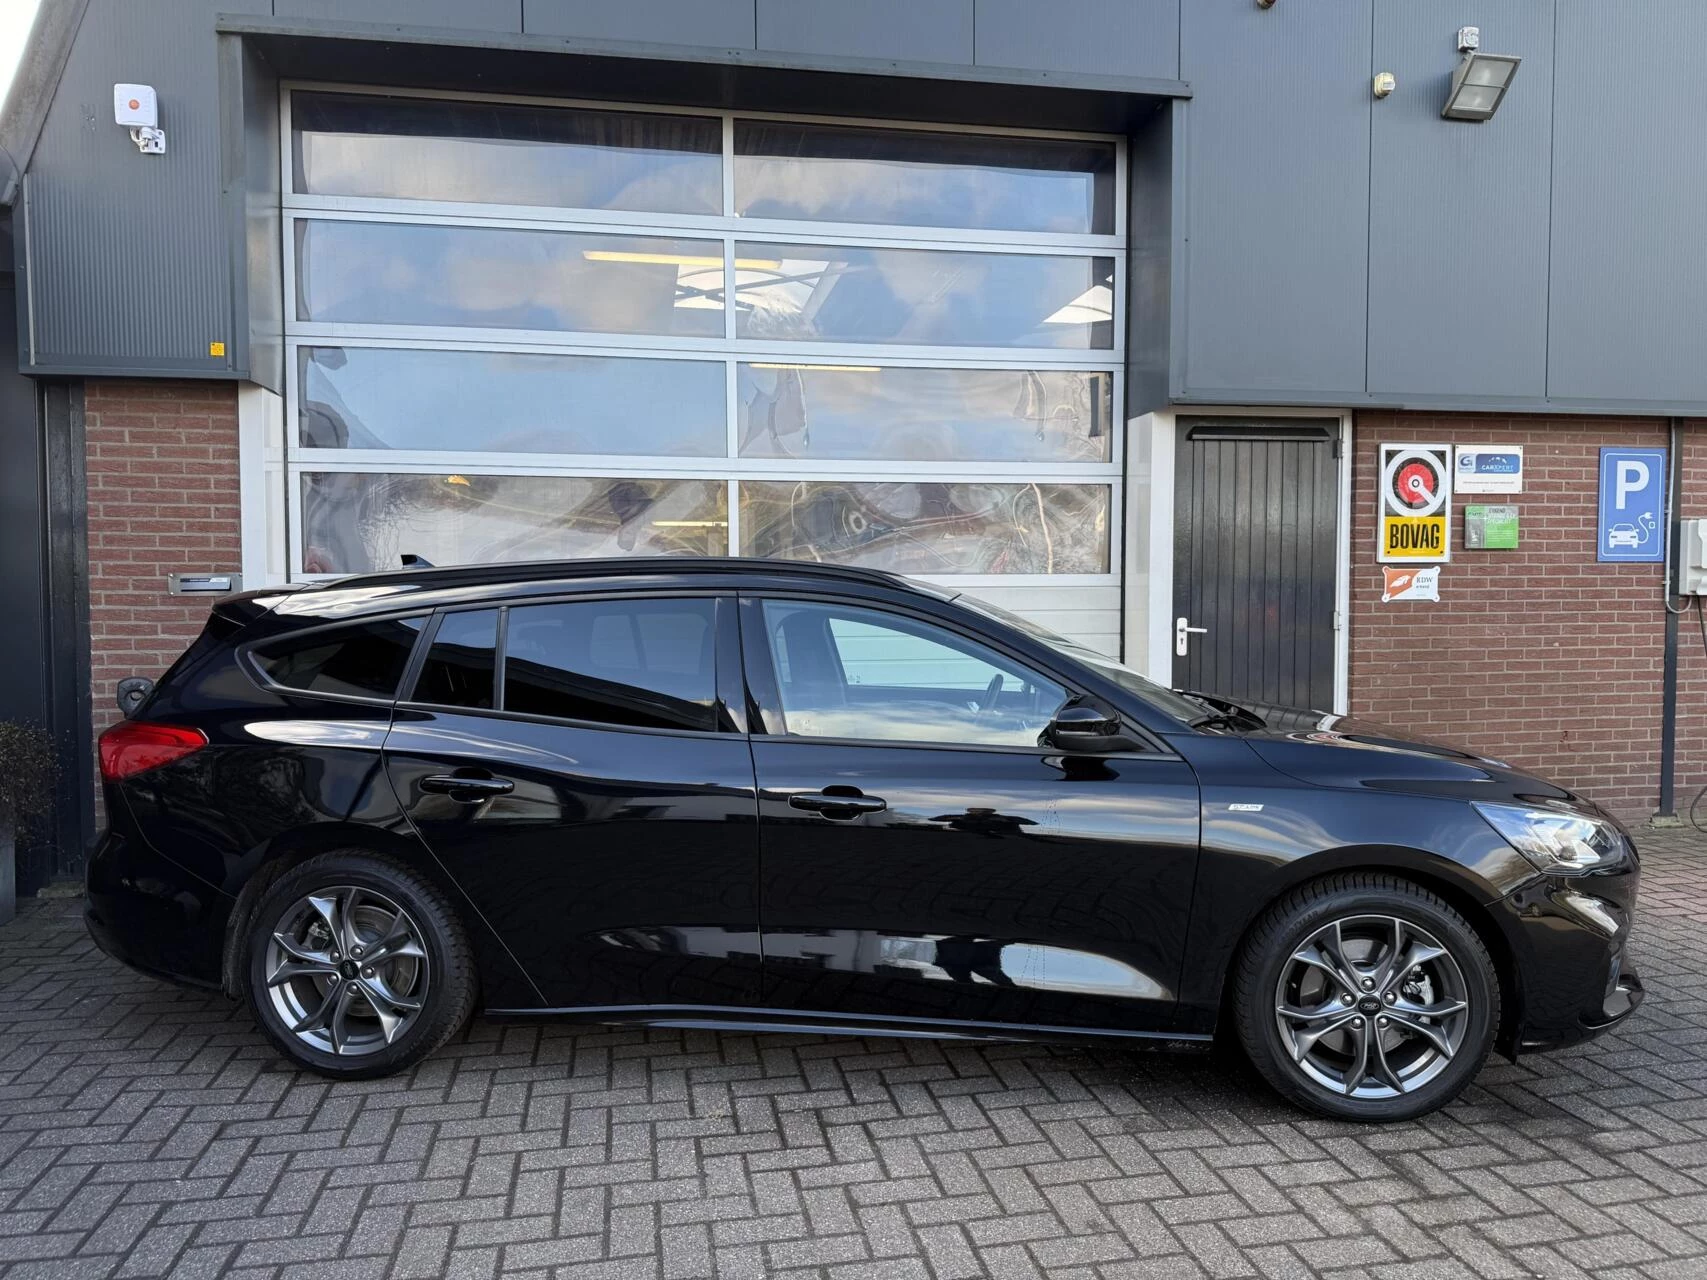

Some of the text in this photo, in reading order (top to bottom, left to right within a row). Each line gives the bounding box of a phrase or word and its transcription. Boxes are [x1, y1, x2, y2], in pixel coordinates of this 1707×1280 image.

[1615, 460, 1650, 510] P
[1390, 523, 1440, 549] BOVAG
[1416, 576, 1433, 584] RDW
